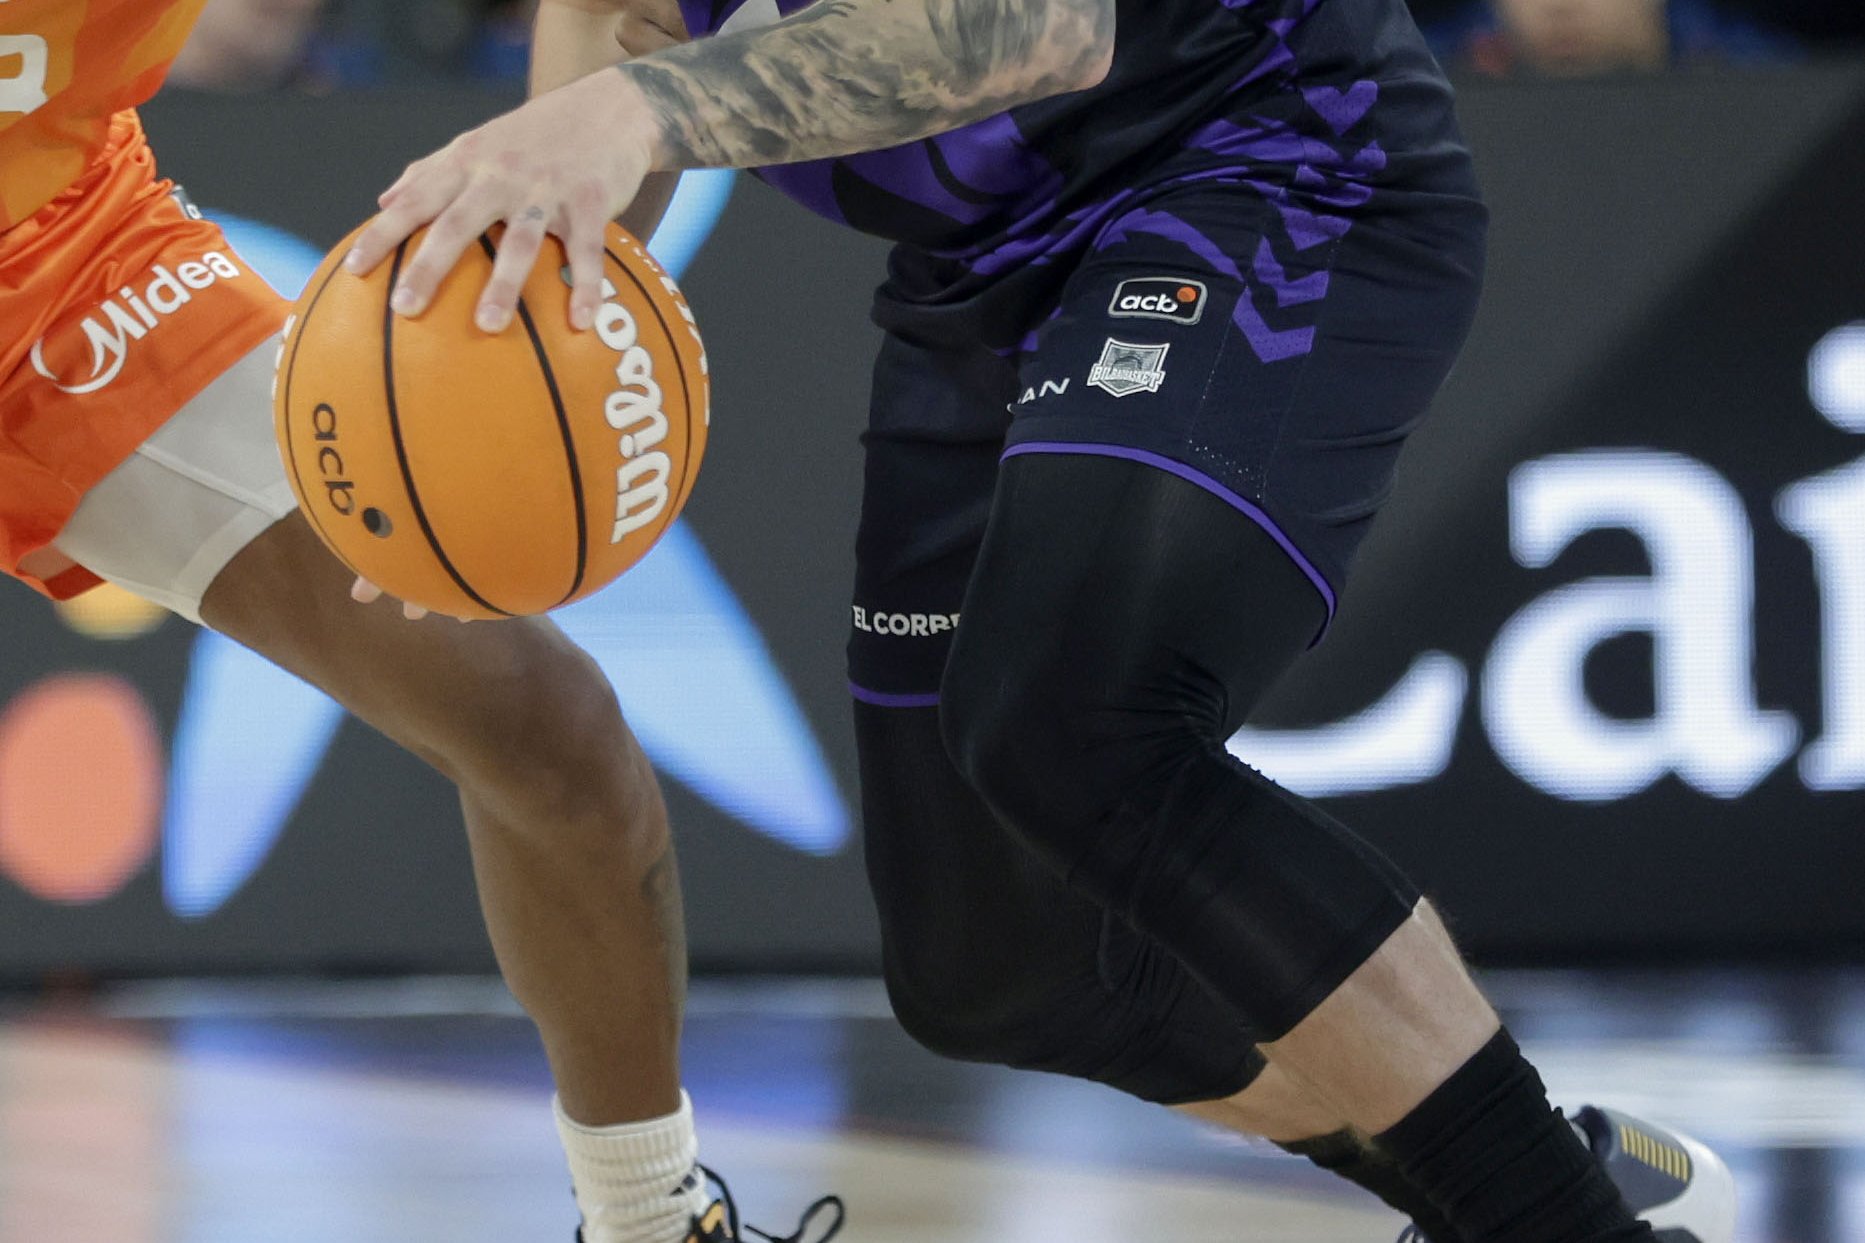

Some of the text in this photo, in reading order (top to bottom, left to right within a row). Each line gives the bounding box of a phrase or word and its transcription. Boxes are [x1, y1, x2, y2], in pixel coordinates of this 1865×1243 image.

[29, 250, 241, 395] Midea
[1120, 293, 1179, 313] acb
[312, 402, 356, 517] acb
[593, 277, 673, 545] Wilso
[852, 605, 873, 632] EL
